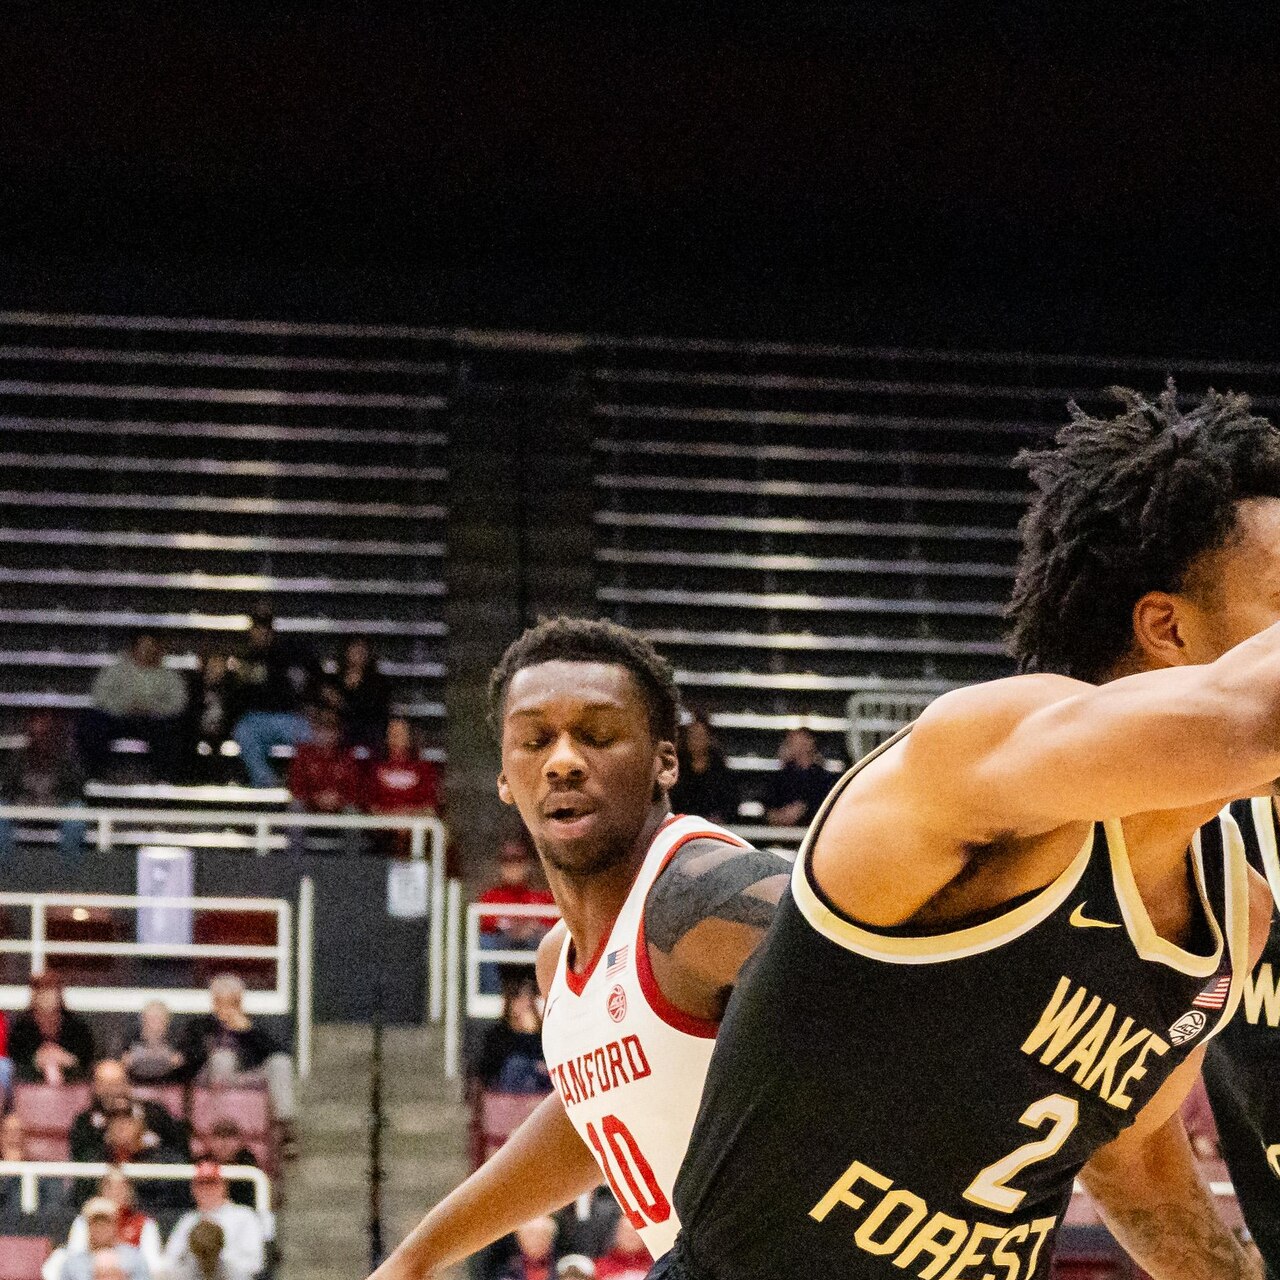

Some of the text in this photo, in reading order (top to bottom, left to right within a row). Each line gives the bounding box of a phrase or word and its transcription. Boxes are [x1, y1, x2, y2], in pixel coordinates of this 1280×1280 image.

[549, 1034, 652, 1107] TANFORD
[1020, 975, 1171, 1111] WAKE
[585, 1114, 672, 1231] 10
[961, 1093, 1079, 1214] 2
